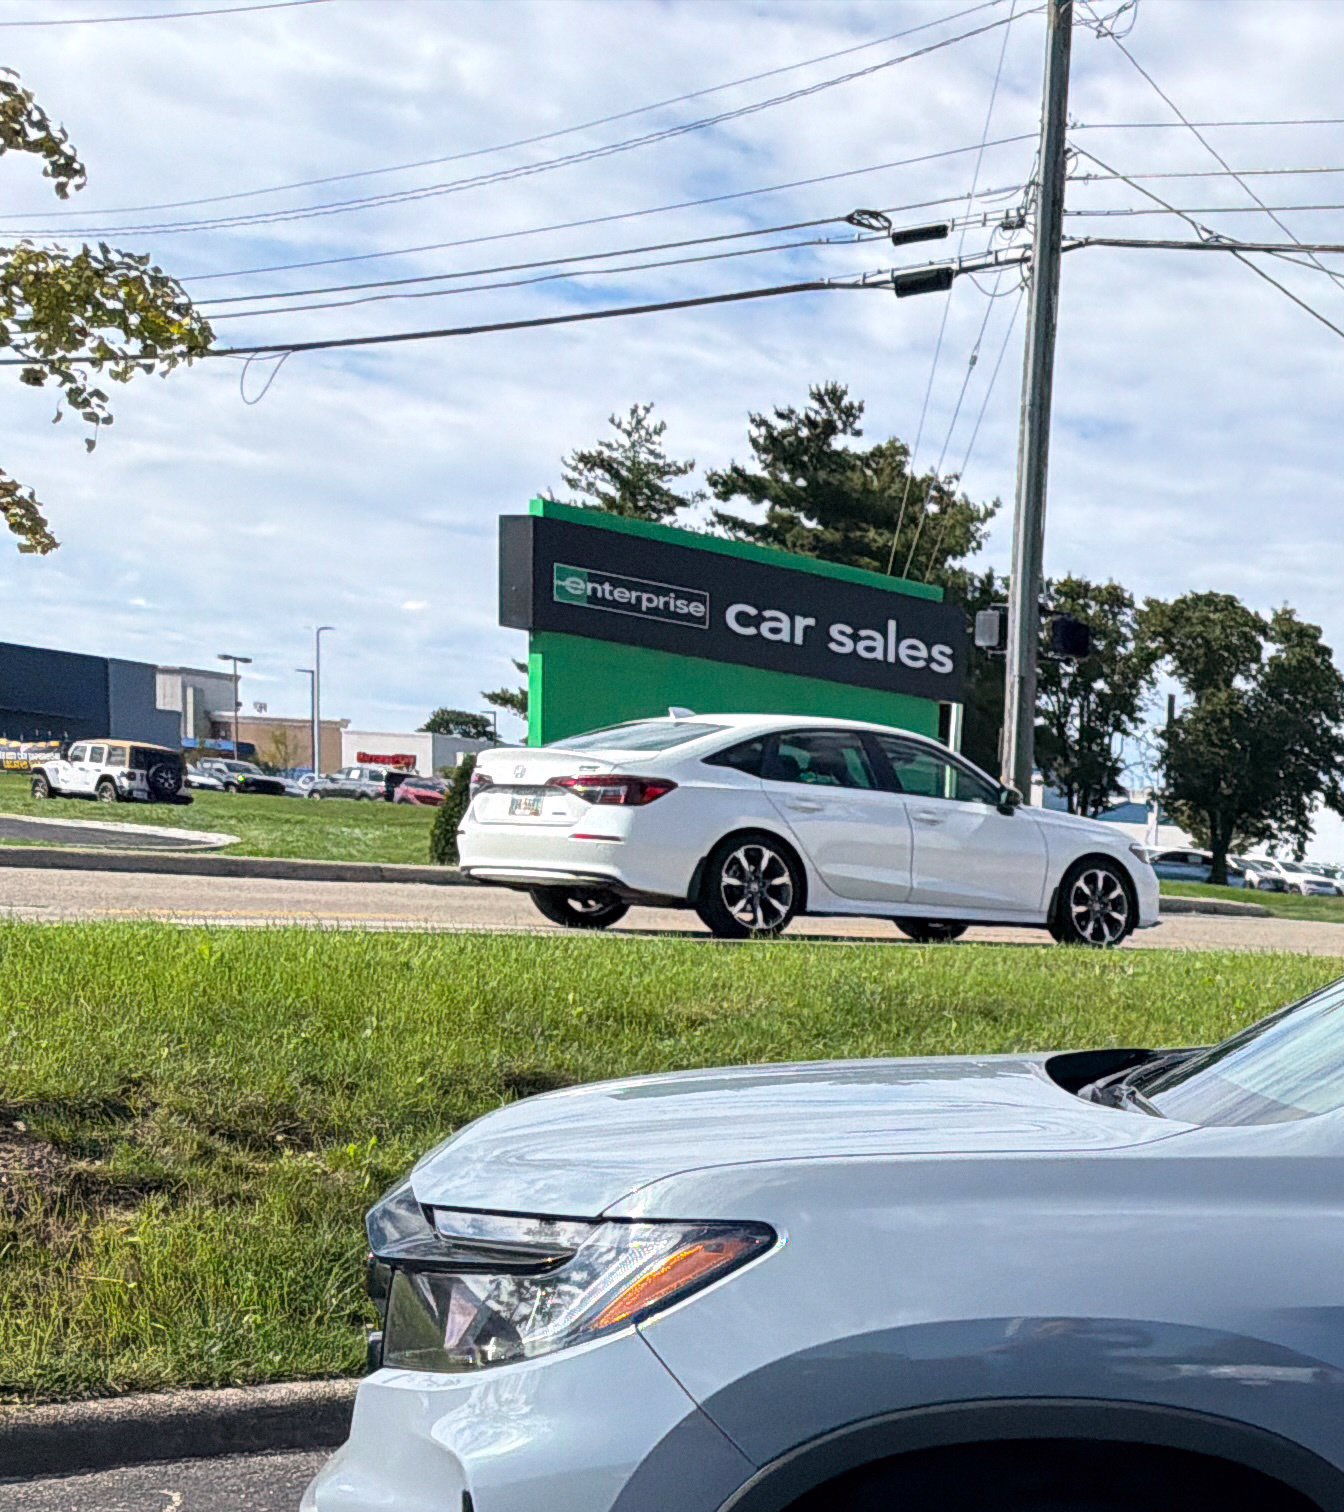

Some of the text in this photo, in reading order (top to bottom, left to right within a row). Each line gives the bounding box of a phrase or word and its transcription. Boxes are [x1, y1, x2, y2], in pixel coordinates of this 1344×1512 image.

[561, 576, 955, 675] enterprise car sales
